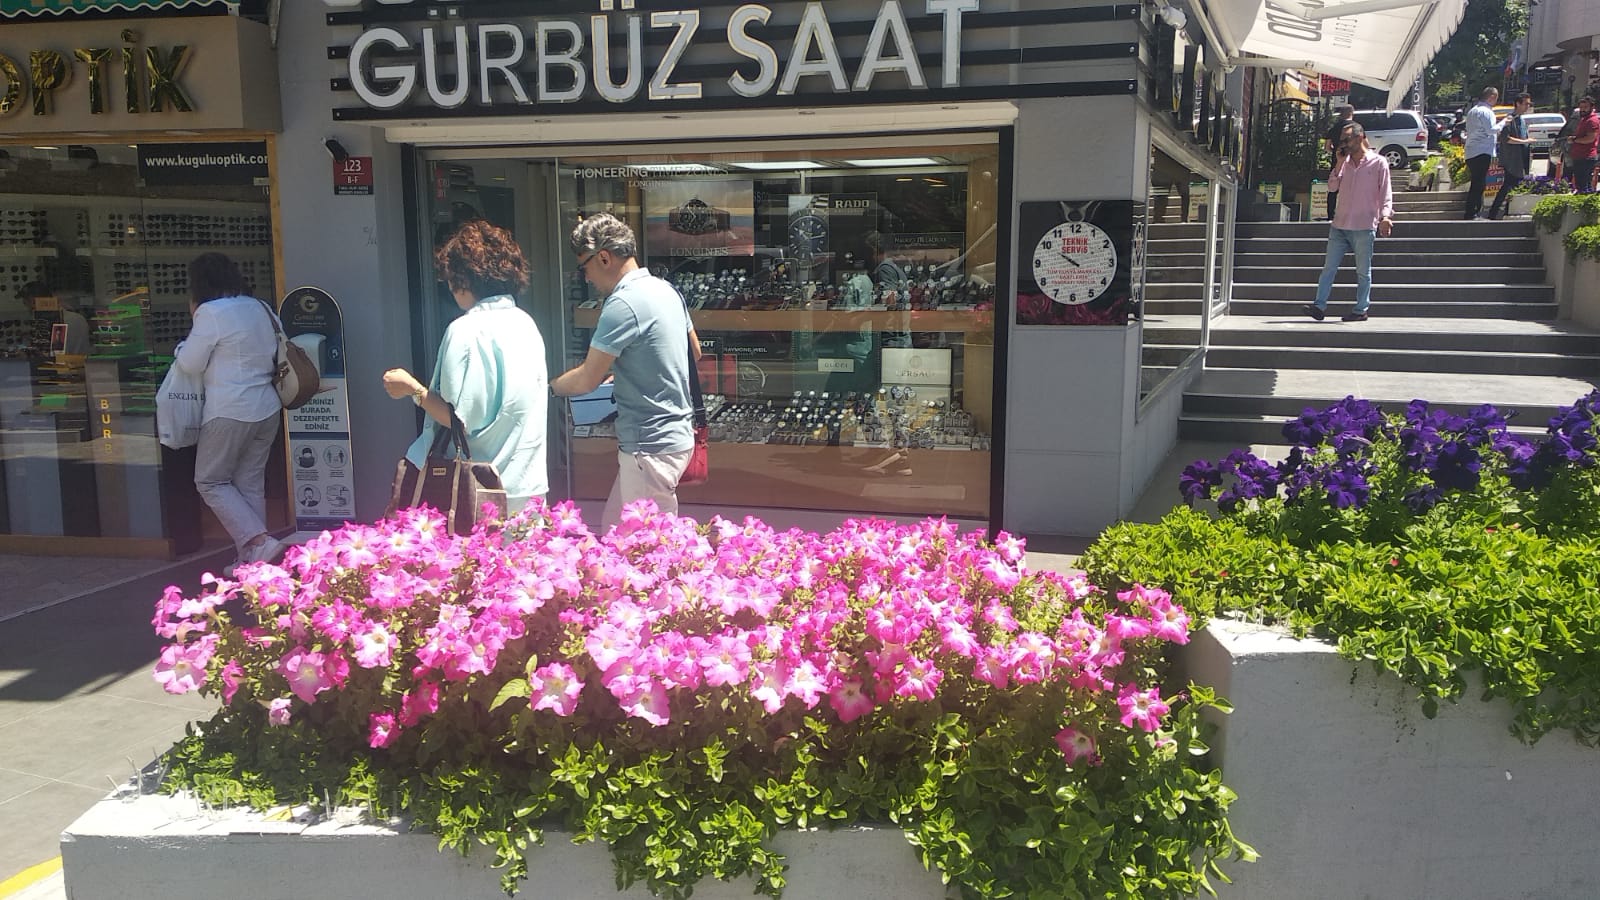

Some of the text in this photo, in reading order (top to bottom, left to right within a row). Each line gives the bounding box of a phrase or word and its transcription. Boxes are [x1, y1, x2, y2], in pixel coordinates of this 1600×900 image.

[348, 0, 980, 109] GÜRBÜZ SAAT
[344, 159, 361, 172] 123
[574, 167, 648, 179] PIONEERING
[835, 199, 870, 209] RADO
[1053, 228, 1096, 238] 11 1
[1070, 224, 1082, 233] 12
[1042, 239, 1110, 249] 10 2
[670, 246, 729, 257] LONGINES
[1034, 258, 1114, 268] 9 3
[1040, 277, 1107, 286] 8 4
[1053, 288, 1095, 298] 7 5
[1069, 293, 1076, 302] 6
[304, 422, 330, 430] EDİNİZ
